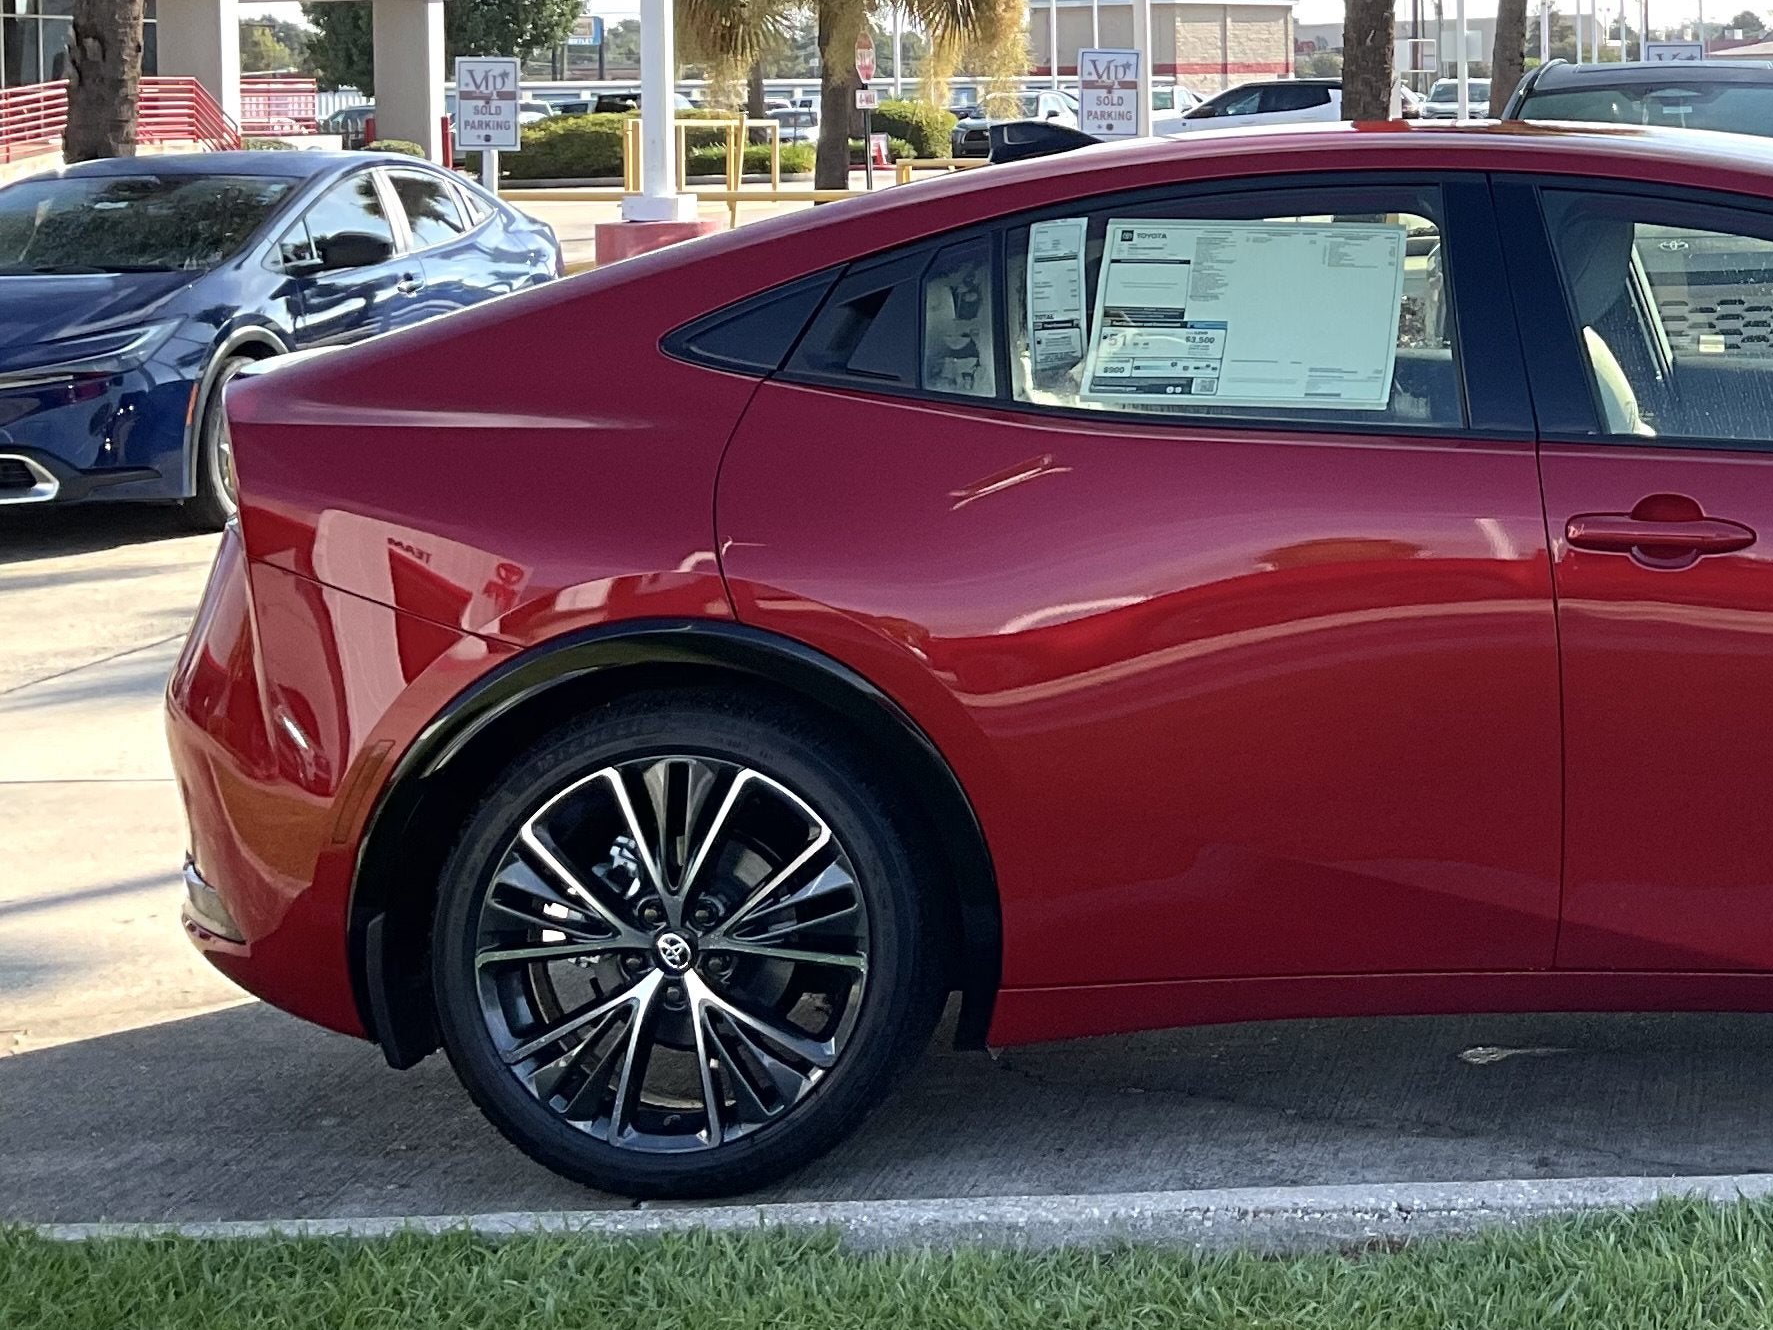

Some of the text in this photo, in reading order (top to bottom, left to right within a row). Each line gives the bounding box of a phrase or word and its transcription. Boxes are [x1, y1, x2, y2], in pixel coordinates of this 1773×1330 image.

[1096, 95, 1124, 107] SOLD
[473, 104, 502, 116] SOLD
[1086, 110, 1133, 121] PARKING
[463, 120, 511, 131] PARKING
